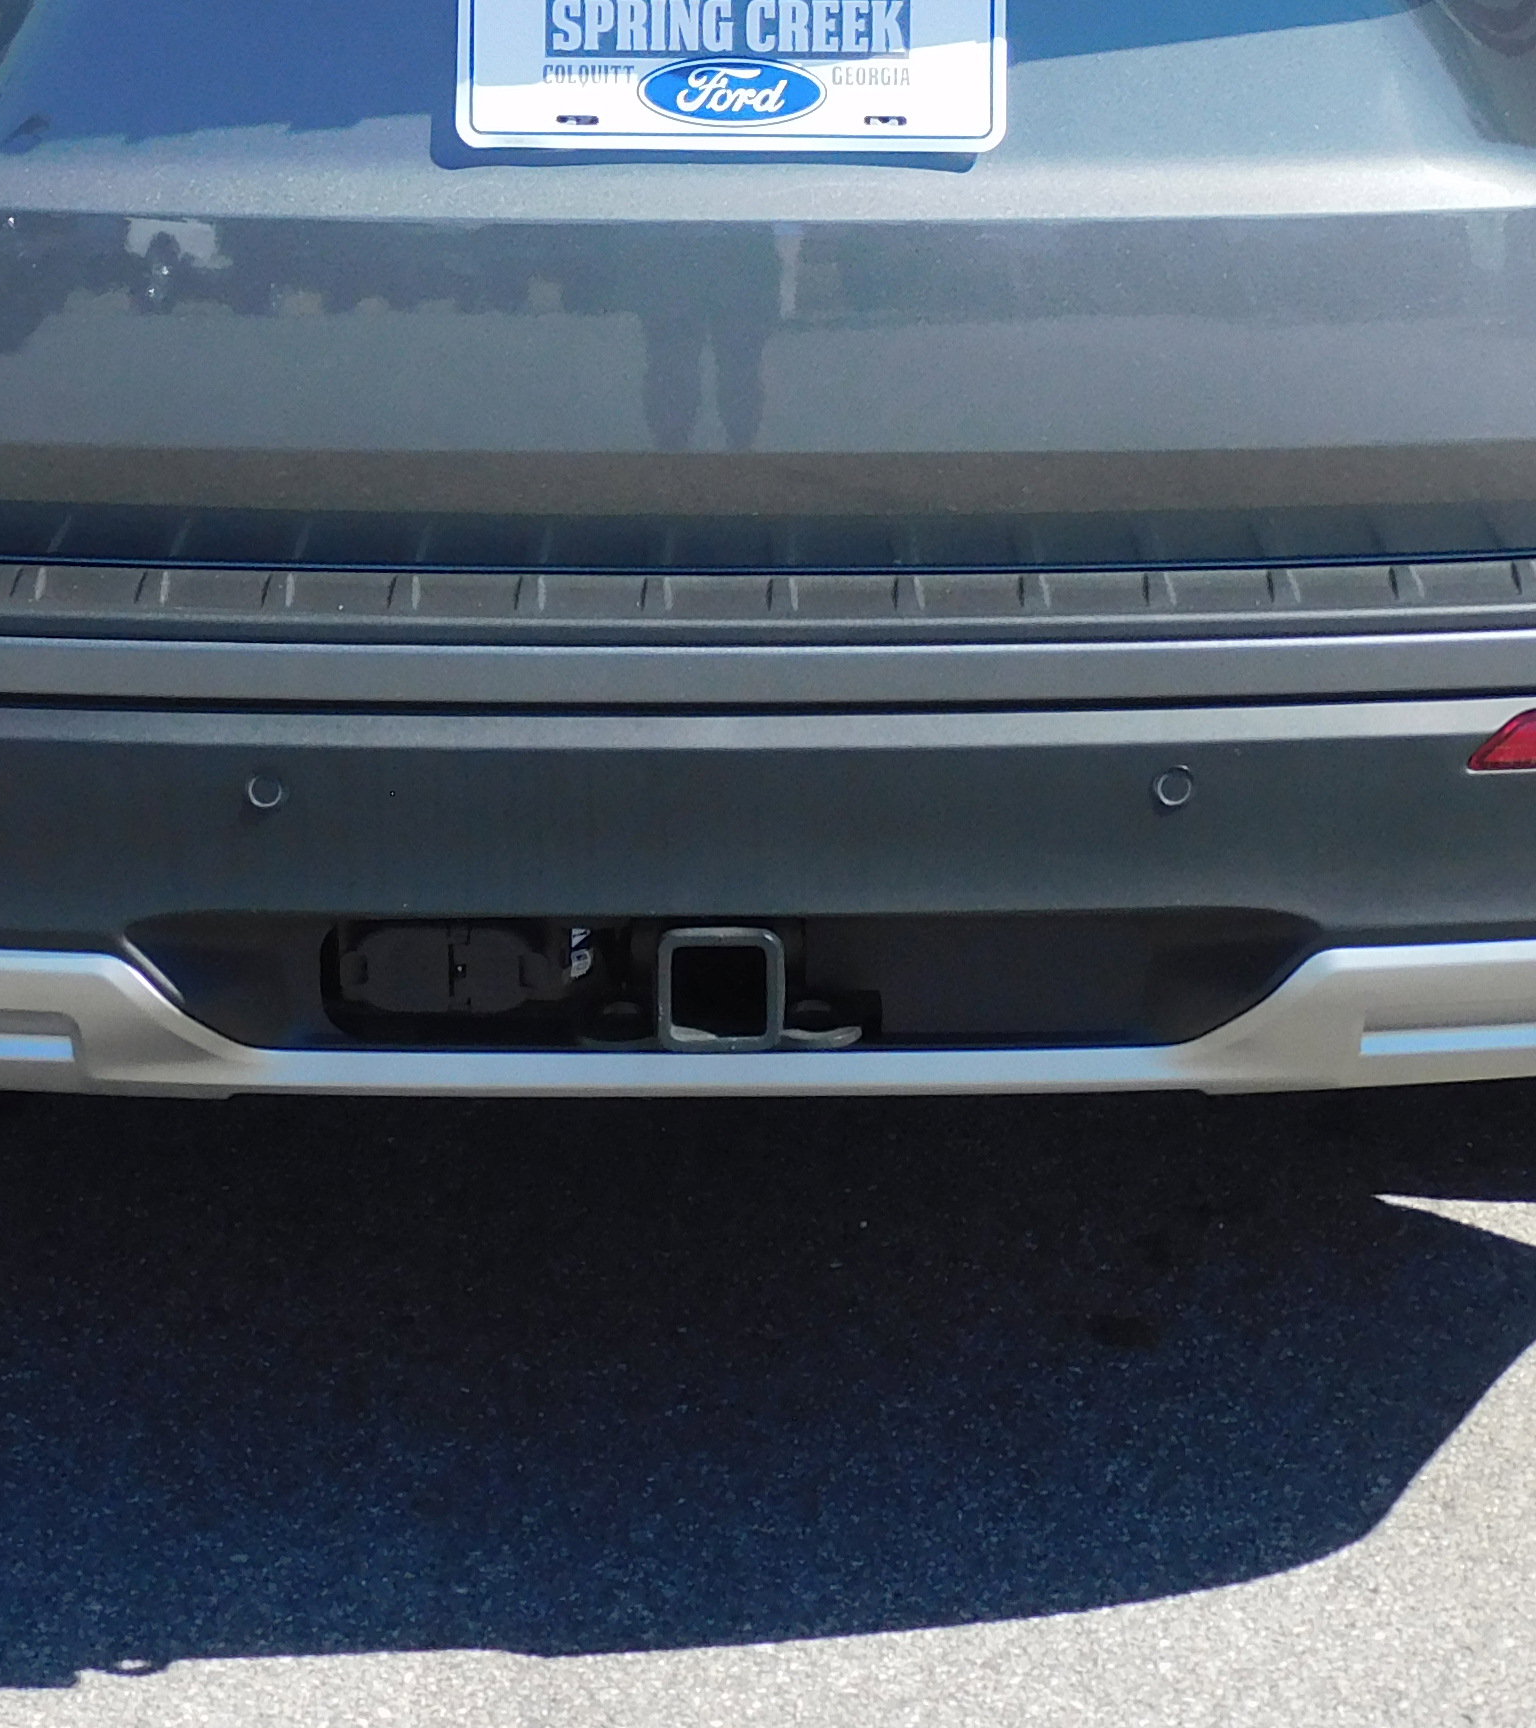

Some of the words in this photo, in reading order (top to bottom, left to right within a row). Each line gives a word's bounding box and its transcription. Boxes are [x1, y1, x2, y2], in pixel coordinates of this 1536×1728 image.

[542, 63, 635, 88] COLQUITT
[676, 66, 789, 113] Ford
[831, 65, 911, 86] GEORGIA
